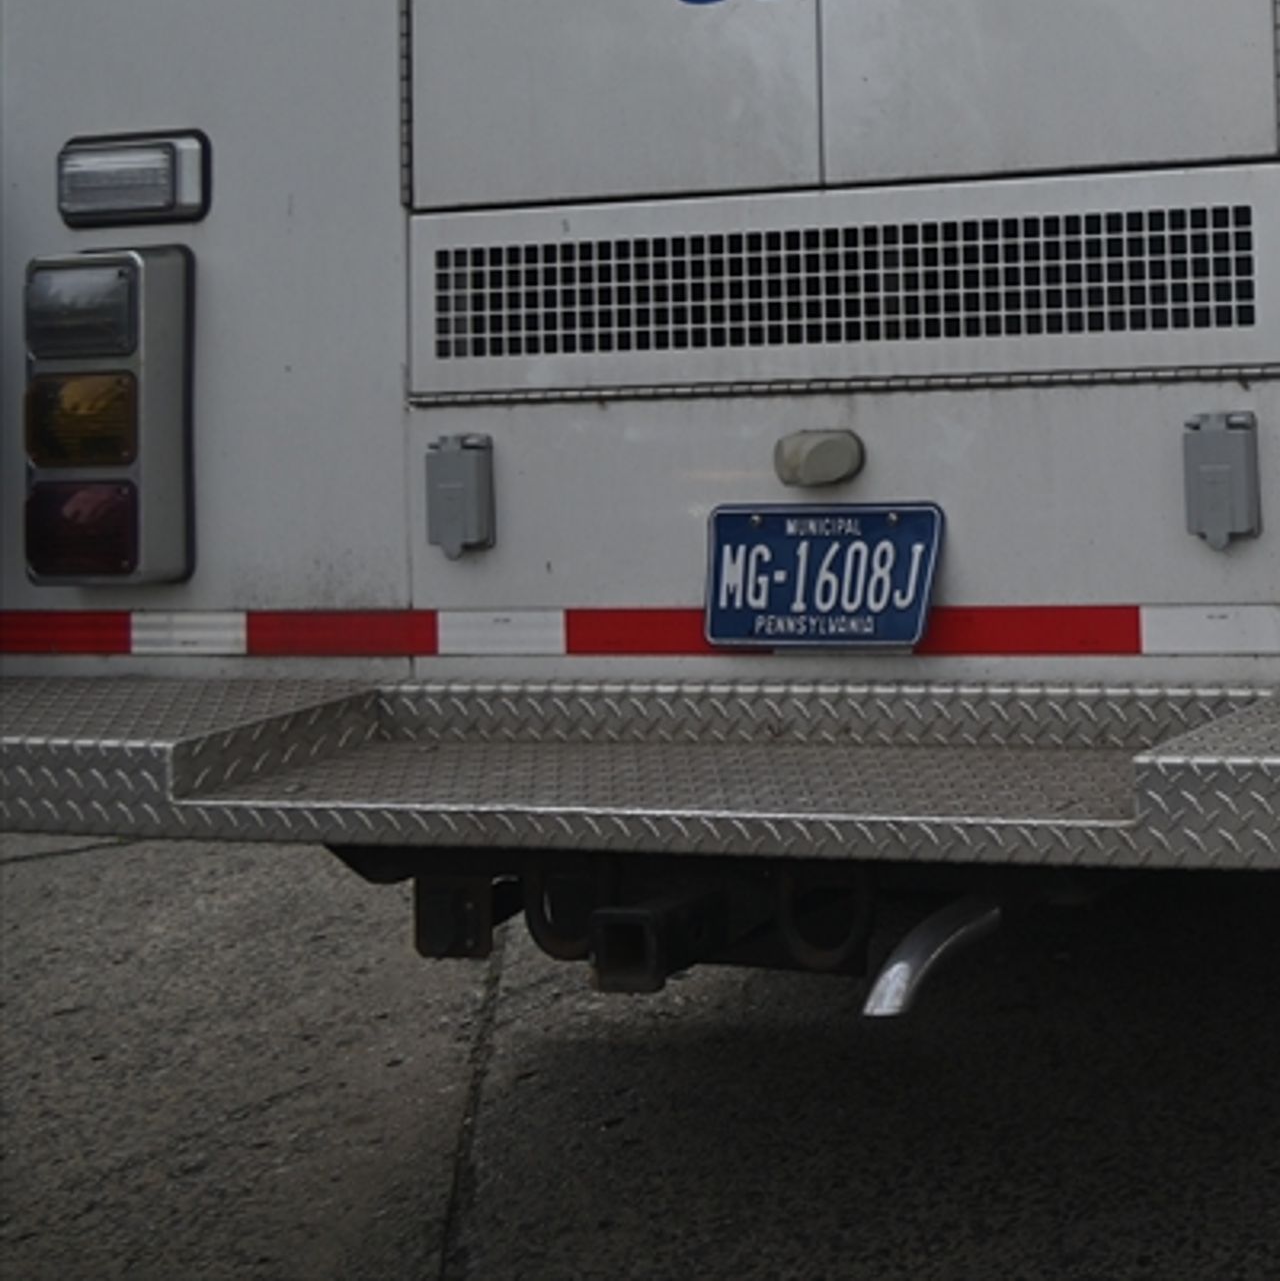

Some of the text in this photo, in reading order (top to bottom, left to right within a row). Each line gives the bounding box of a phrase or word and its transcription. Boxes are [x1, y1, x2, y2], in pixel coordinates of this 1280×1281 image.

[786, 518, 862, 536] MUNICIPAL
[719, 540, 925, 613] MG-1608J
[755, 615, 875, 634] PENNSYLVANIA
